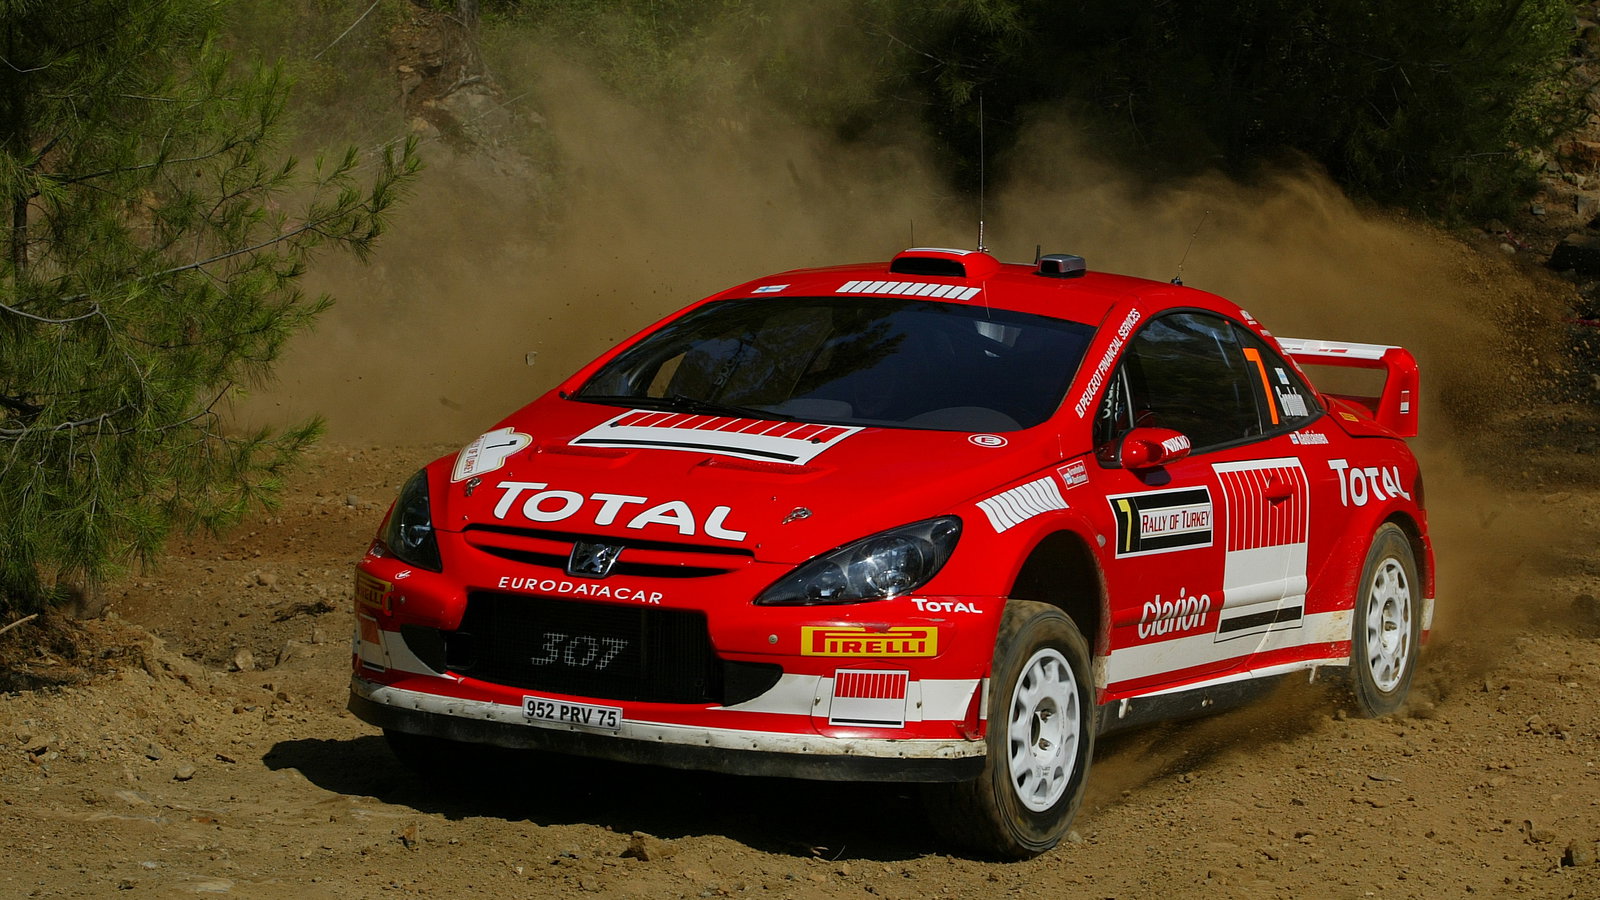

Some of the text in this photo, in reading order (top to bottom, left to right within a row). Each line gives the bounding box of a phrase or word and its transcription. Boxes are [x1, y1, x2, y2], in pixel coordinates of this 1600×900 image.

[1080, 368, 1103, 411] PEUGEOT
[1098, 336, 1123, 376] FINANCIAL
[1117, 308, 1141, 340] SERVICES
[1242, 348, 1279, 425] 7
[1327, 458, 1411, 507] TOTAL
[492, 481, 747, 541] TOTAL
[1117, 499, 1132, 552] 7
[1141, 510, 1211, 534] RALLY OF TURKEY
[498, 576, 663, 605] EURODATACAR
[911, 598, 983, 614] TOTAL
[1138, 587, 1211, 639] clarion
[531, 632, 629, 670] 307
[811, 629, 928, 653] PIRELLI
[527, 700, 617, 728] 952 PRV 75
